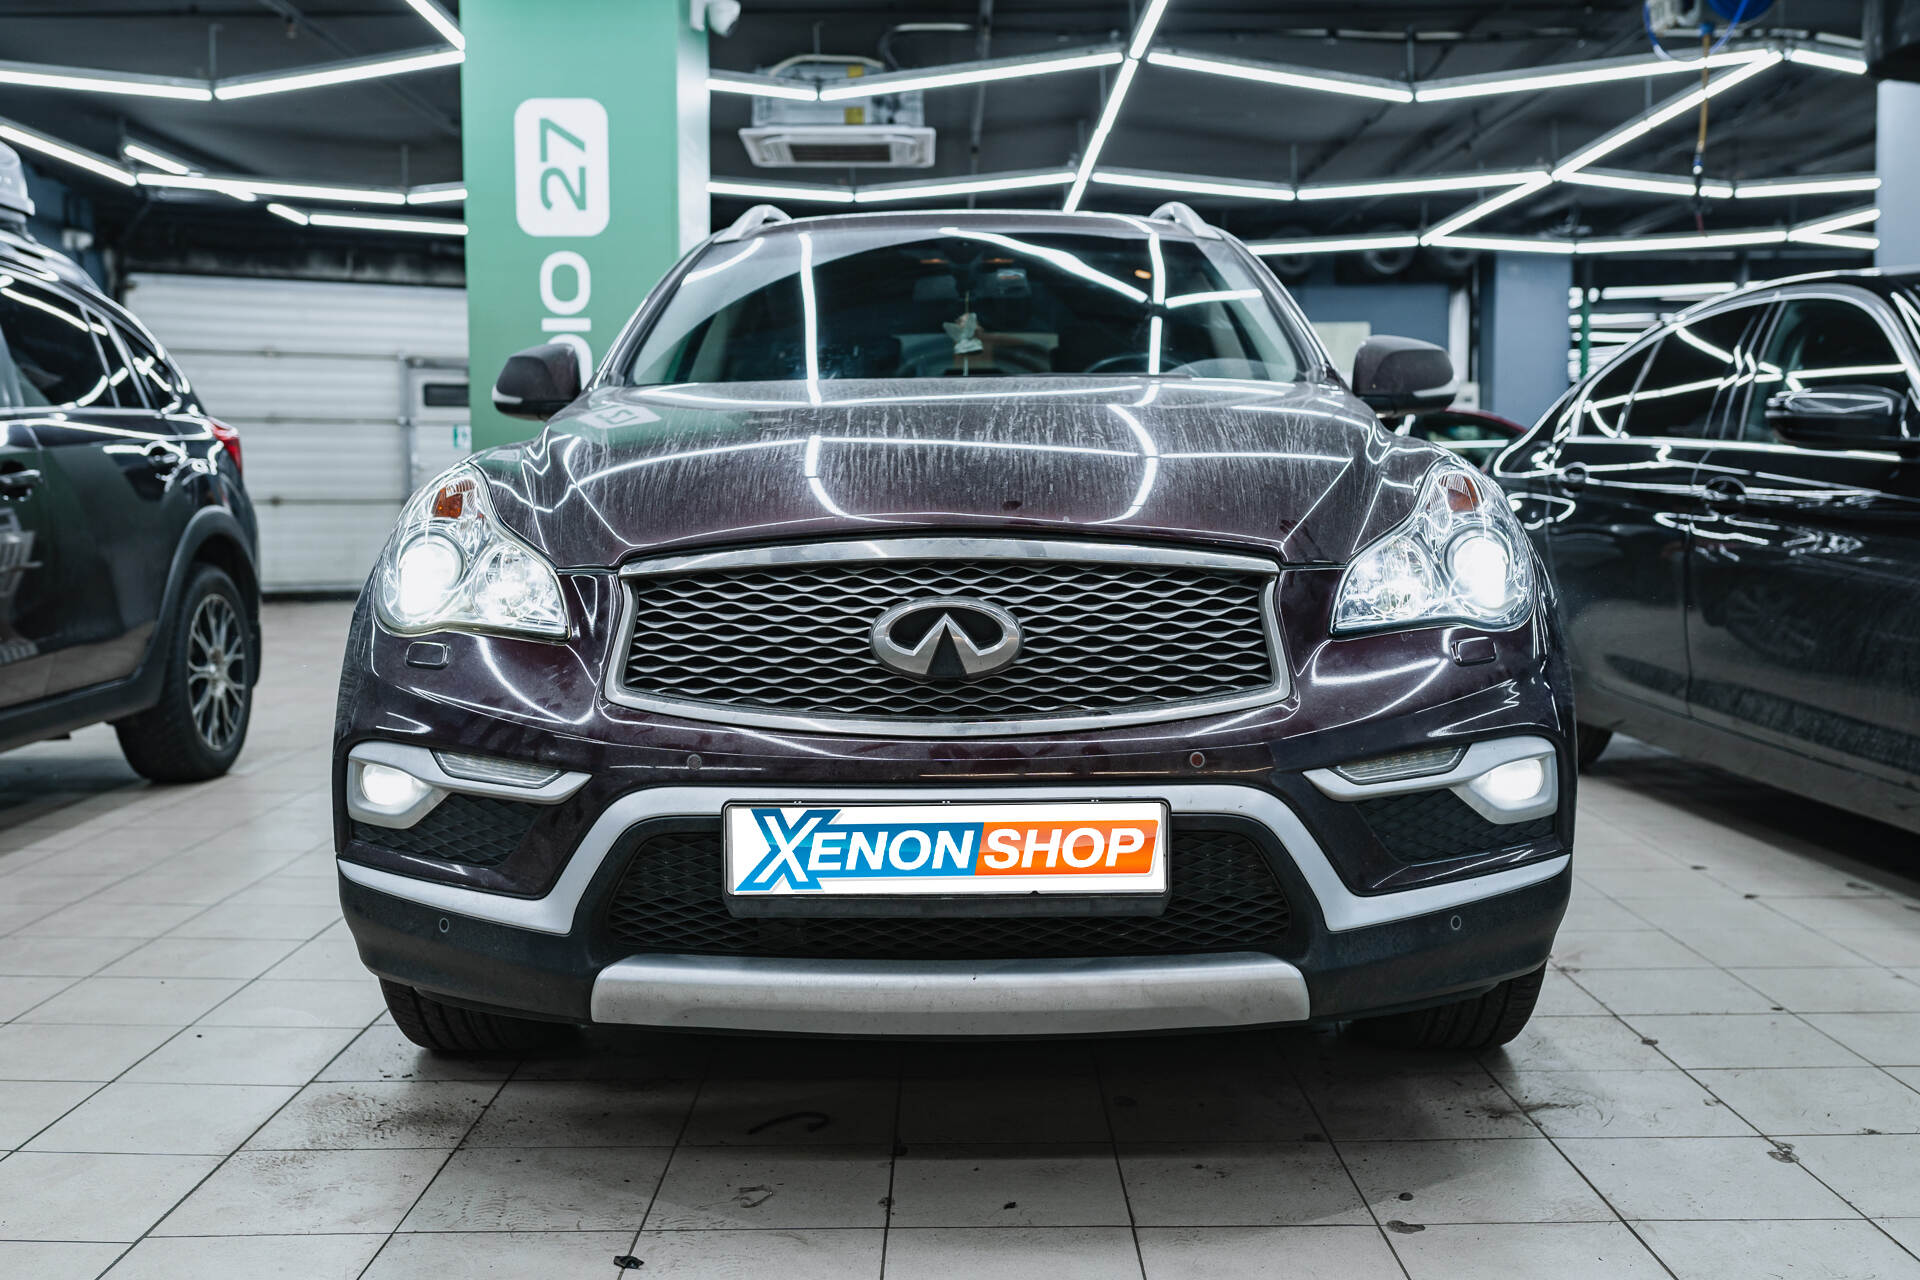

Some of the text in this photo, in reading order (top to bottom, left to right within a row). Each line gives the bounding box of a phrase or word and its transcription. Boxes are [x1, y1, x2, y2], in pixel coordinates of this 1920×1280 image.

[539, 117, 587, 211] 27
[752, 813, 1146, 884] XENON SHOP
